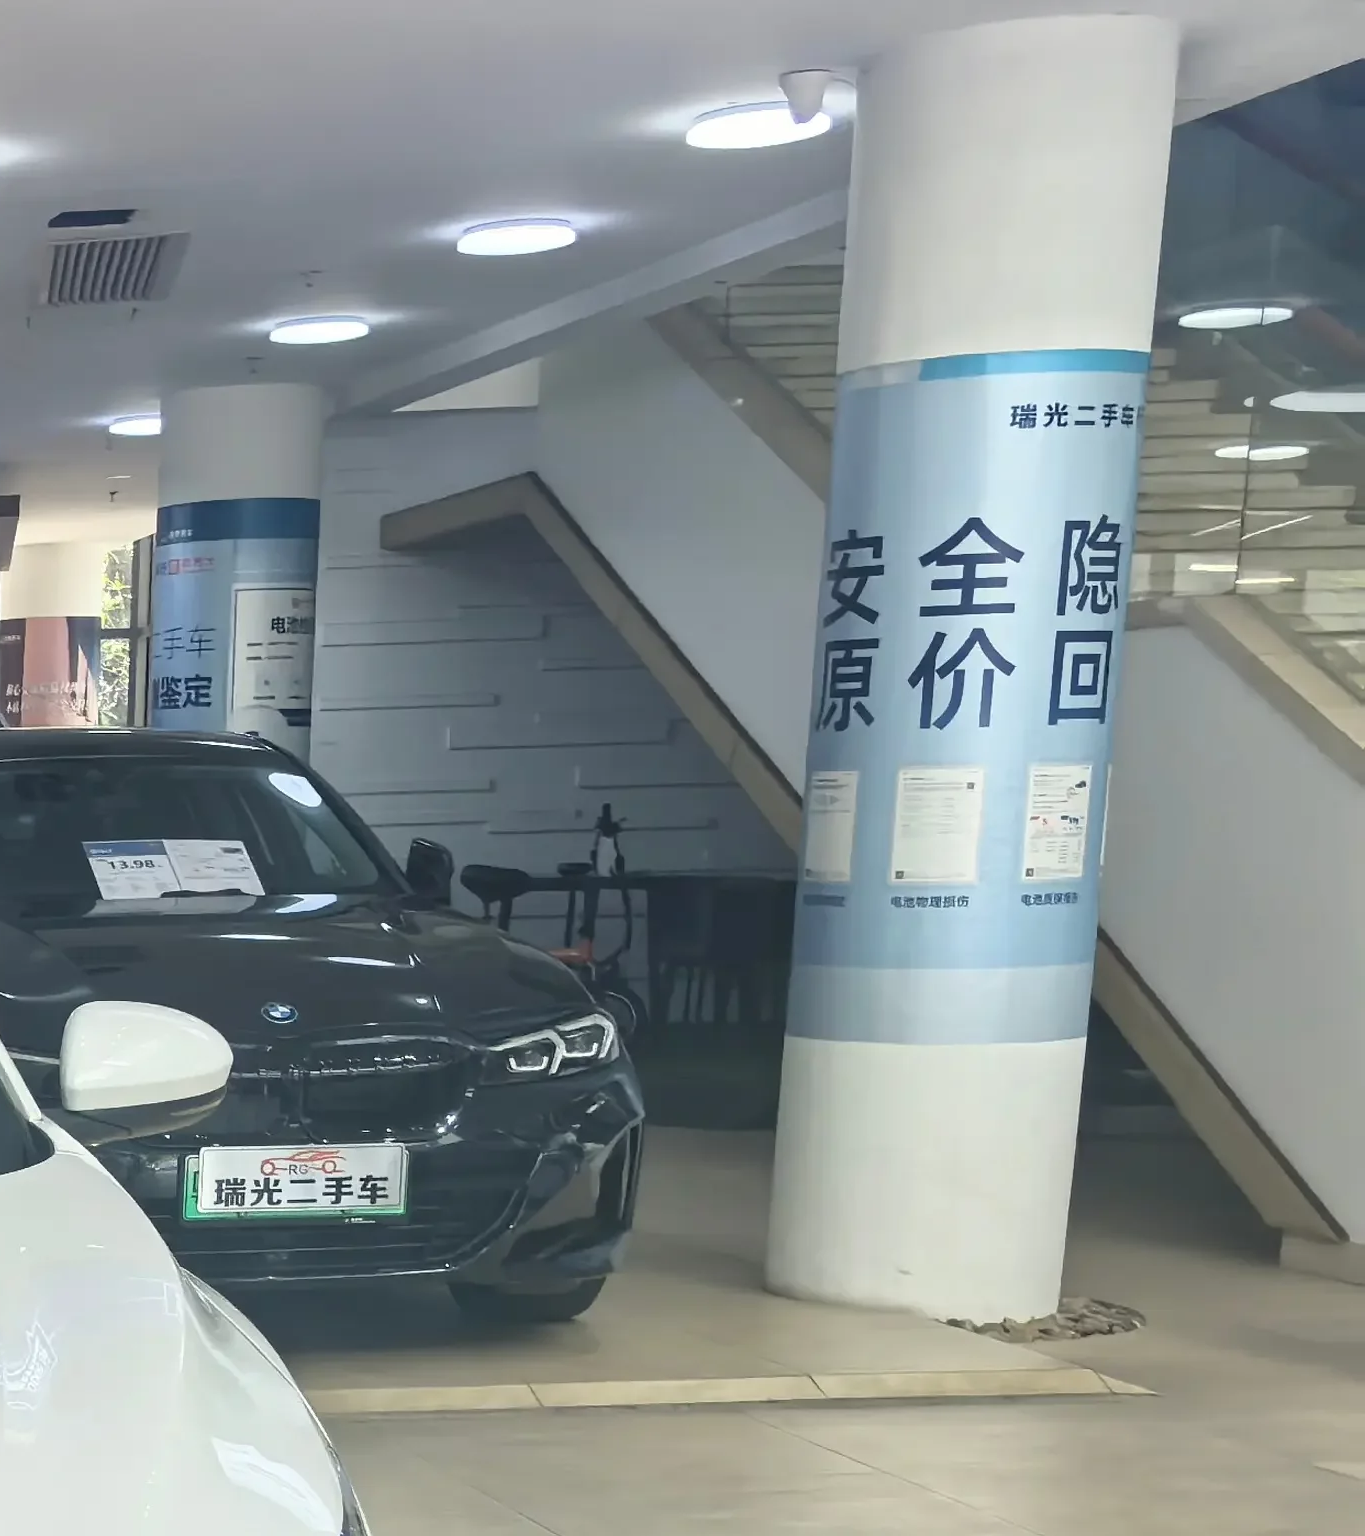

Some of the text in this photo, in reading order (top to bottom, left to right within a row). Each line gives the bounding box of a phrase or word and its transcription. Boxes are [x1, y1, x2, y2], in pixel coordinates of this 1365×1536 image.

[1009, 401, 1145, 429] 瑞光二手车
[154, 674, 212, 709] 鉴定
[213, 1174, 390, 1208] 瑞光二手车
